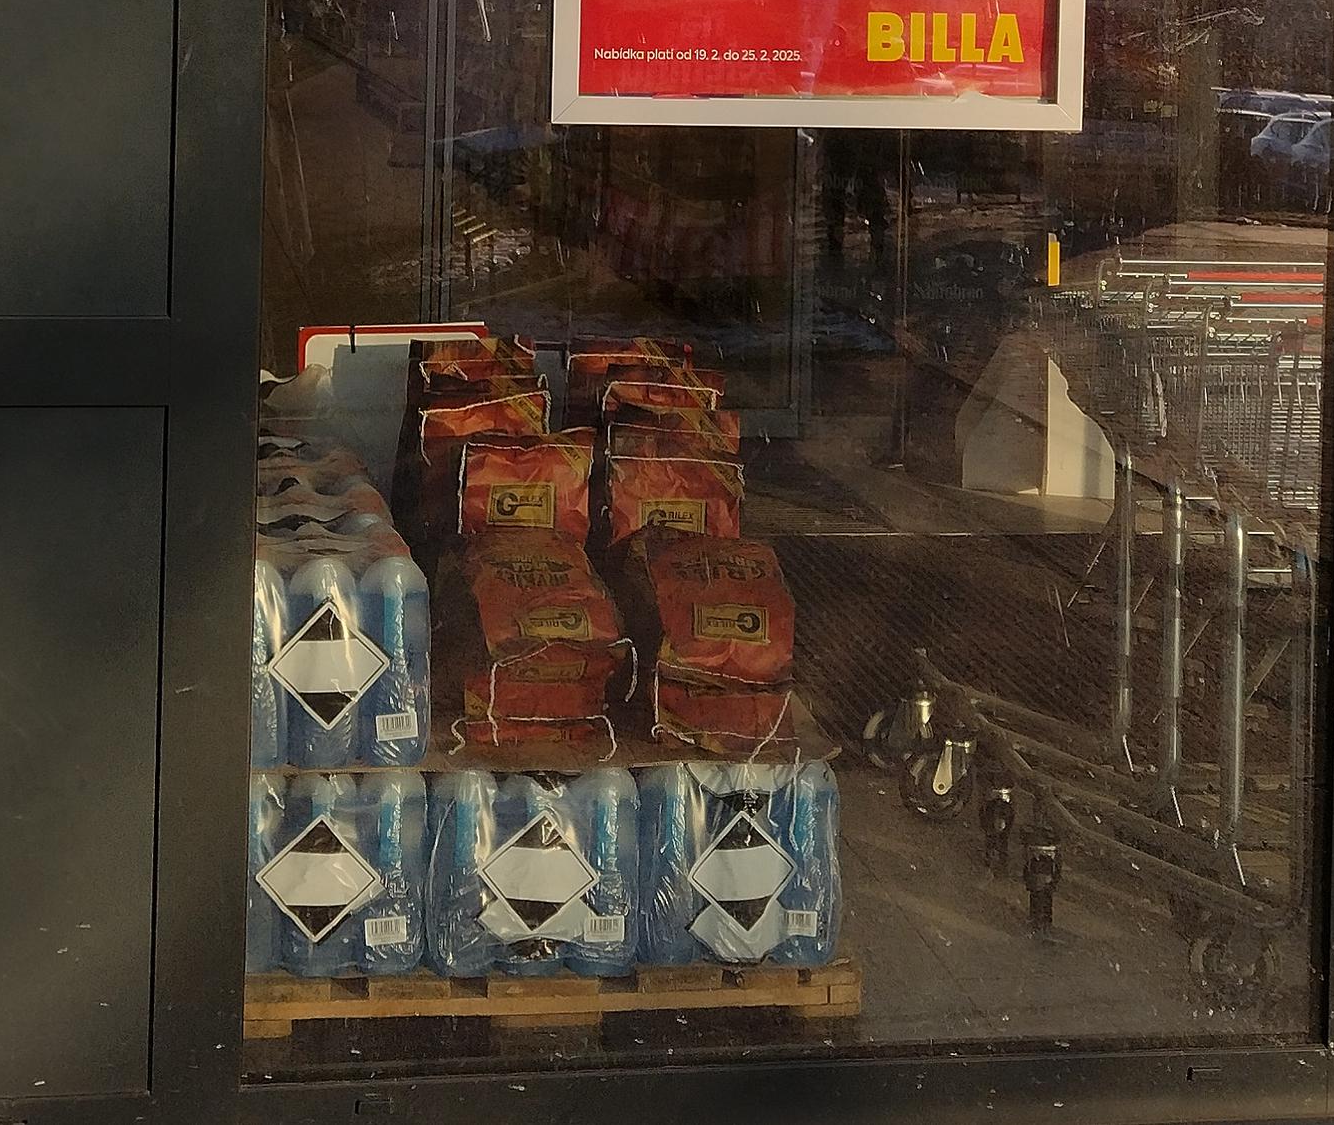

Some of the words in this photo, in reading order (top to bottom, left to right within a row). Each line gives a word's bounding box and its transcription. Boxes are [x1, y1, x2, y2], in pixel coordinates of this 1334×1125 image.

[867, 11, 1024, 63] BILLA
[594, 48, 645, 60] Nabídka
[647, 48, 674, 62] platí
[676, 49, 692, 60] od
[694, 50, 709, 60] 19.
[711, 50, 721, 60] 2.
[723, 49, 739, 60] do
[742, 50, 758, 61] 25.
[761, 50, 771, 61] 2.
[773, 50, 802, 61] 2025.
